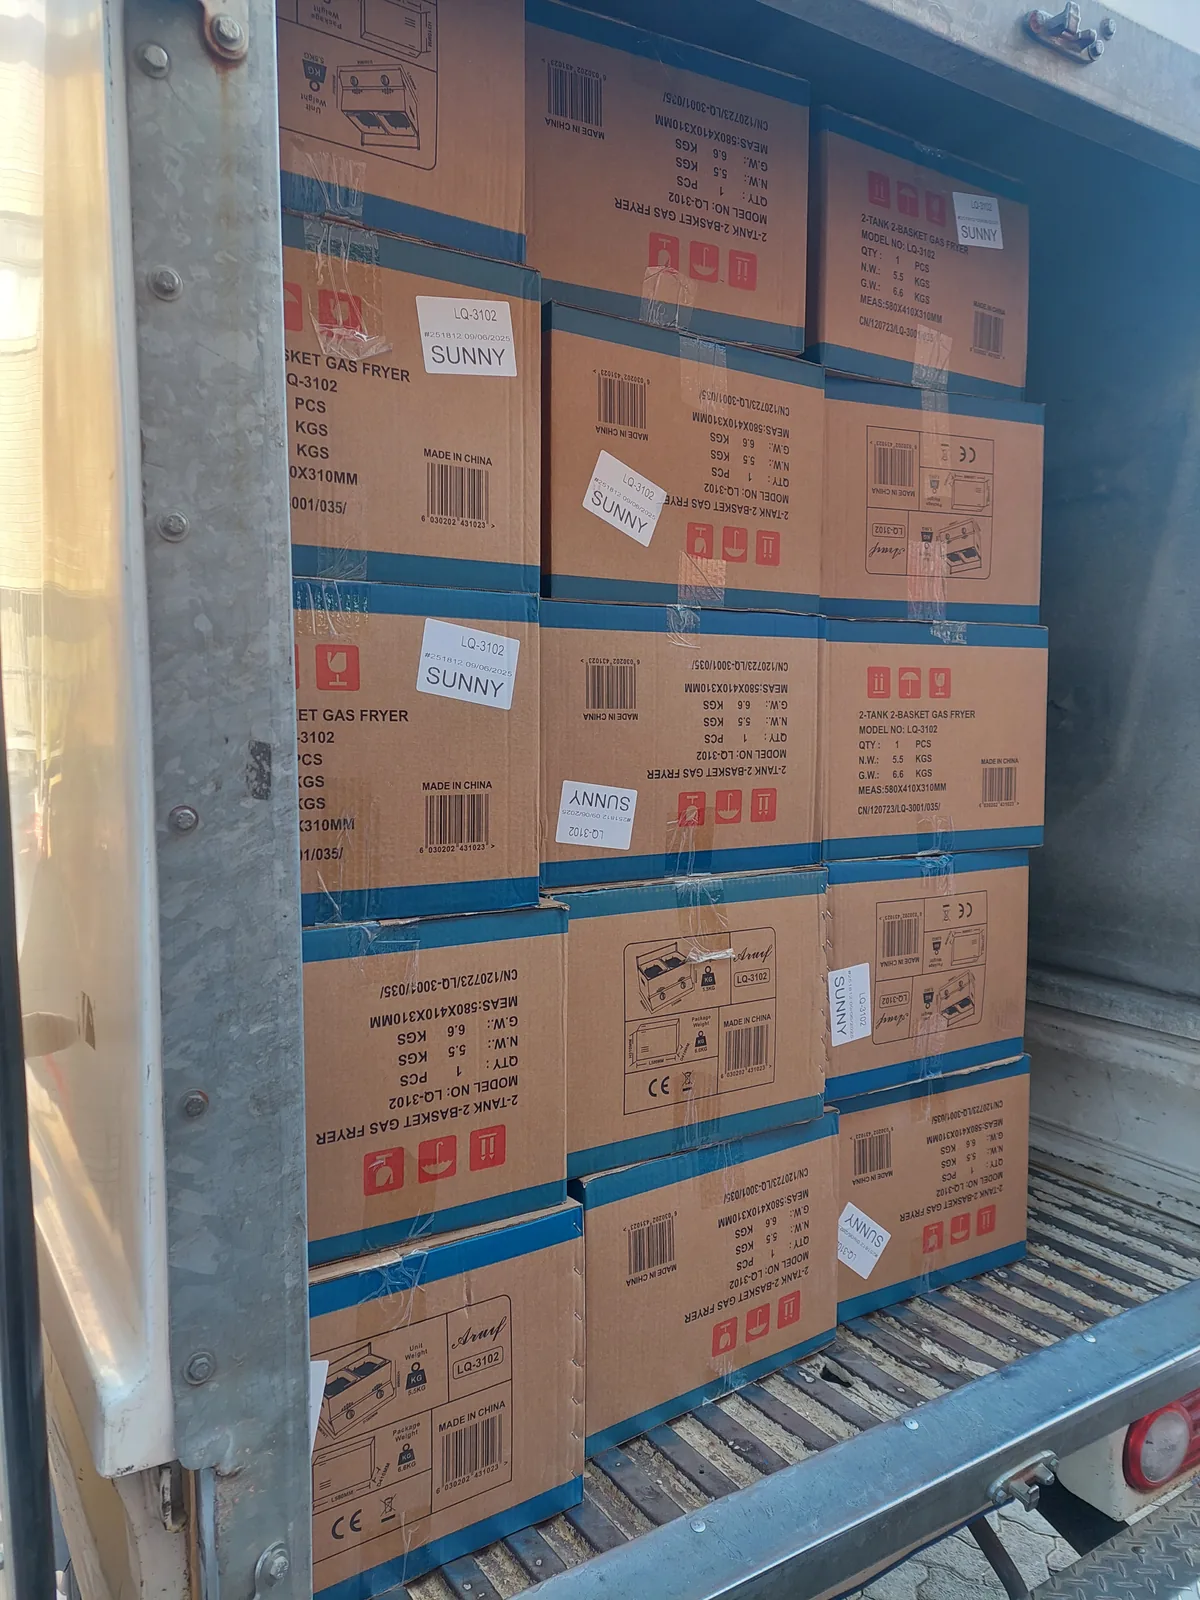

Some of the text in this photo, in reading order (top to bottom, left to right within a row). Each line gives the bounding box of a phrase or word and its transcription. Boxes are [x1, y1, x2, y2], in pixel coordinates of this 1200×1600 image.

[300, 93, 327, 107] Weight
[305, 103, 321, 114] Unit
[663, 92, 769, 131] CN/120723/LQ-3001/035/
[655, 114, 768, 154] MEAS:580X410X310MM
[675, 138, 768, 171] G.W.: 6.6 KGS
[675, 157, 768, 189] N.W.: 5.5 KGS
[668, 191, 767, 224] MODEL NO: LQ-3102
[614, 197, 767, 242] 2-TANK 2-BASKET GAS FRYER
[861, 214, 969, 255] 2-TANK 2-BASKET GAS FRYER
[960, 225, 997, 242] SUNNY
[861, 229, 935, 260] MODEL NO: LQ-3102
[453, 307, 497, 322] LQ-3102
[860, 295, 943, 324] MEAS:580X410X310MM
[424, 332, 511, 342] #251812 09/06/2025
[431, 345, 505, 367] SUNNY
[325, 356, 411, 383] GAS FRYER
[295, 396, 326, 414] PCS
[699, 389, 790, 416] CN/120723/LQ-3001/035/
[295, 420, 328, 436] KGS
[595, 425, 649, 441] MADE IN CHINA
[692, 411, 790, 438] MEAS:580X410X310MM
[296, 443, 329, 459] KGS
[423, 448, 493, 466] MADE IN CHINA
[622, 472, 656, 501] LQ-3102
[704, 483, 789, 504] MODEL NO: LQ-3102
[590, 490, 649, 534] SUNNY
[691, 498, 789, 520] 2-TANK 2-BASKET GAS
[430, 516, 486, 529] 030202 431023
[875, 526, 903, 535] LQ-3102
[460, 635, 505, 656] LQ-3102
[424, 652, 513, 677] #251812 09/06/2025
[692, 660, 788, 671] CN/120723/LQ-3001/035/
[425, 666, 505, 698] SUNNY
[684, 683, 788, 693] MEAS:580X410X310MM
[322, 709, 409, 722] GAS FRYER
[703, 700, 787, 710] G.W.: 6.6 KGS
[859, 710, 975, 720] 2-TANK 2-BASKET GAS FRYER
[583, 713, 607, 721] CHINA
[703, 717, 787, 727] N.W.: 5.5 KGS
[859, 725, 938, 734] MODEL NO: LQ-3102
[696, 749, 787, 760] MODEL NO: LQ-3102
[858, 754, 932, 765] N.W.: 5.5 KGS
[647, 765, 786, 779] 2-TANK 2-BASKET GAS FRYER
[858, 769, 932, 780] G.W.: 6.6 KGS
[422, 780, 492, 791] MADE IN CHINA
[858, 783, 947, 795] MEAS:580X410X310MM
[569, 790, 631, 811] SUNNY
[858, 803, 941, 816] CN/120723/LQ-3001/035/
[568, 826, 603, 840] LQ-3102
[428, 843, 485, 853] 030202 431023
[380, 968, 518, 999] CN/120723/LQ-3001/035/
[736, 972, 768, 984] LQ-3102
[834, 976, 847, 1036] SUNNY
[882, 995, 907, 1005] LQ-3102
[369, 995, 518, 1029] MEAS:580X410X310MM
[397, 1015, 518, 1045] G.W.: 6.6 KGS
[399, 1035, 518, 1065] N.W.: 5.5 KGS
[388, 1075, 518, 1110] MODEL NO: LQ-3102
[316, 1094, 518, 1145] 2-TANK 2-BASKET GAS FRYER
[926, 1118, 1003, 1145] MEAS:580X410X310MM
[723, 1168, 809, 1204] CN/120723/LQ-3001/035/
[936, 1172, 1003, 1197] MODEL NO: LQ-3102
[718, 1189, 809, 1228] MEAS:580X410X310MM
[900, 1185, 1003, 1222] 2-TANK 2-BASKET GAS FRYER
[844, 1213, 884, 1248] SUNNY
[729, 1251, 809, 1290] MODEL NO: LQ-3102
[684, 1266, 809, 1324] 2-TANK 2-BASKET GAS FRYER
[405, 1349, 428, 1360] Weight
[409, 1343, 423, 1352] Unit
[457, 1352, 500, 1375] LQ-3102
[408, 1385, 426, 1396] 5.5KG
[438, 1400, 506, 1433] MADE IN CHINA
[392, 1422, 421, 1436] Package
[395, 1429, 418, 1443] Weight
[444, 1463, 499, 1491] 030202 431023
